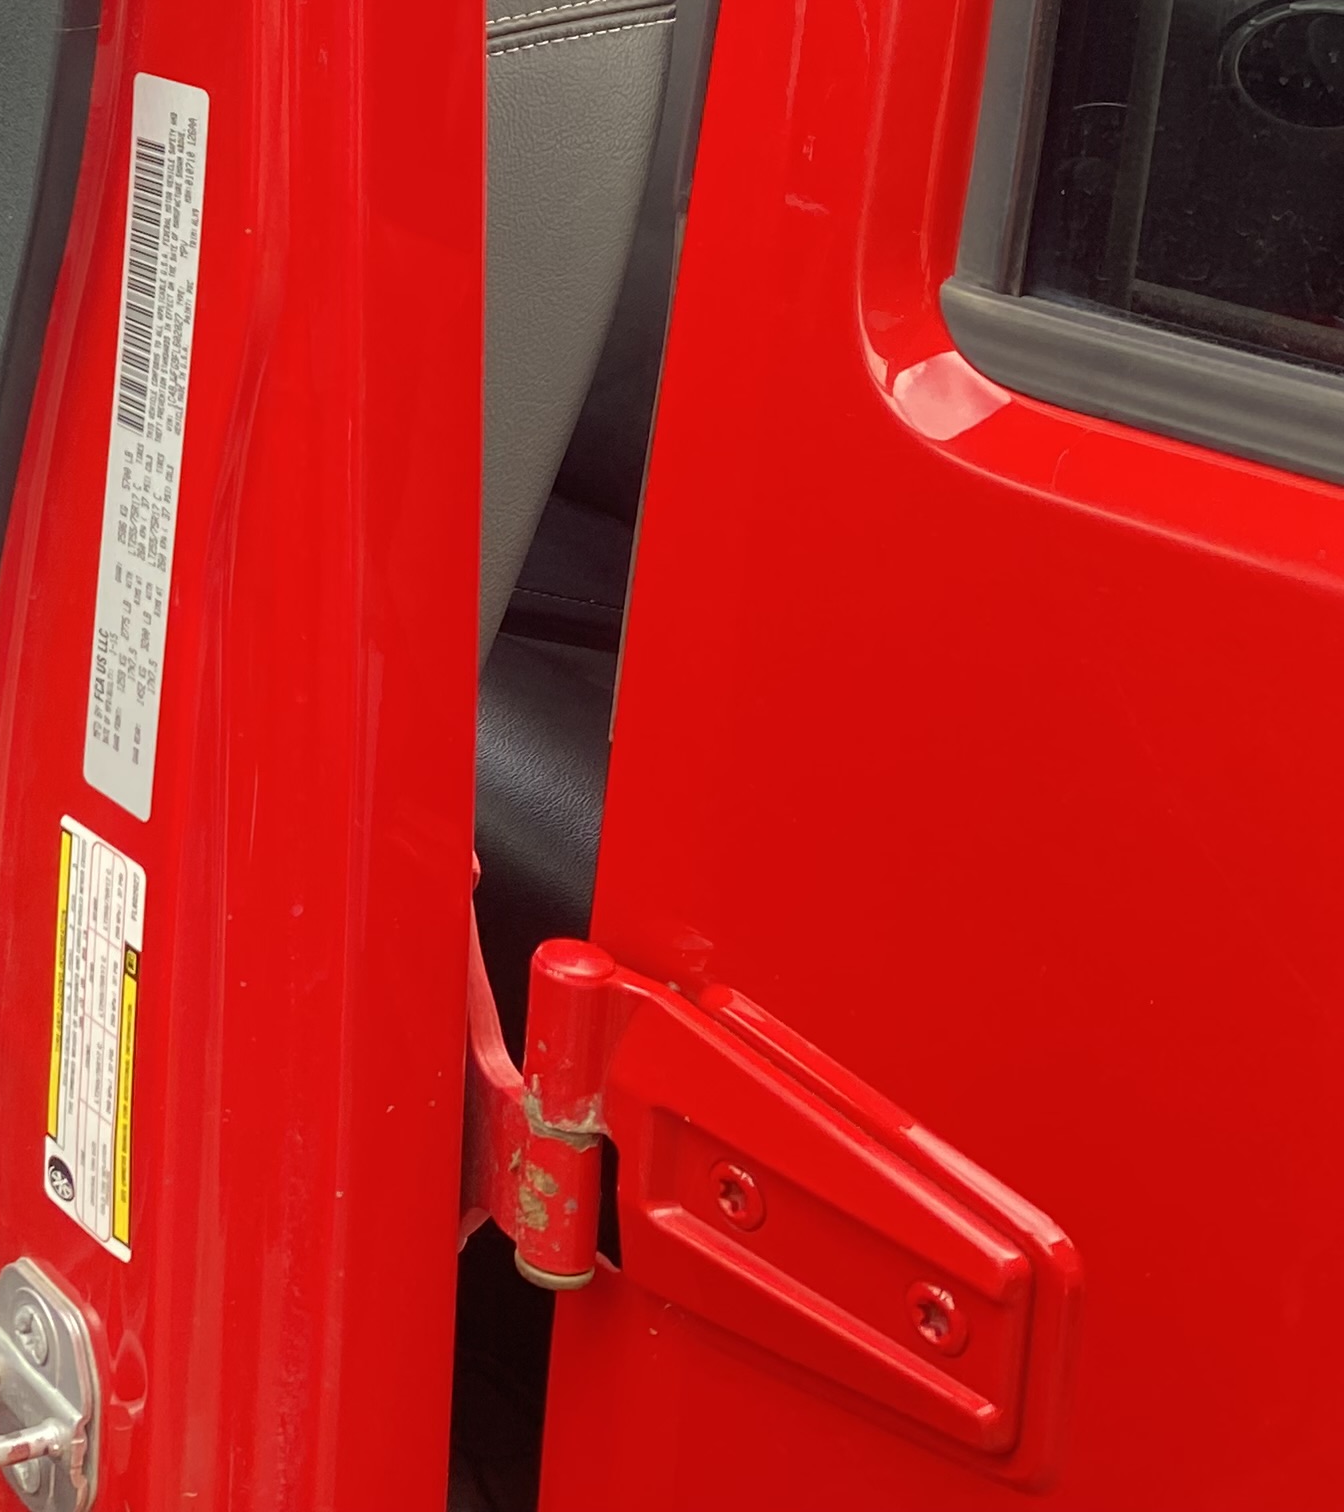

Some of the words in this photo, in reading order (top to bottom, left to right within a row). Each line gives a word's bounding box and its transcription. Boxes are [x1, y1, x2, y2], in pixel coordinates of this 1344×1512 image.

[180, 239, 188, 258] MPV
[124, 450, 133, 464] LB
[142, 496, 150, 510] 37
[163, 507, 171, 521] 37
[123, 599, 132, 614] LB
[143, 610, 152, 626] LB
[98, 626, 109, 654] LLC
[96, 653, 107, 675] US
[94, 674, 105, 703] FCA
